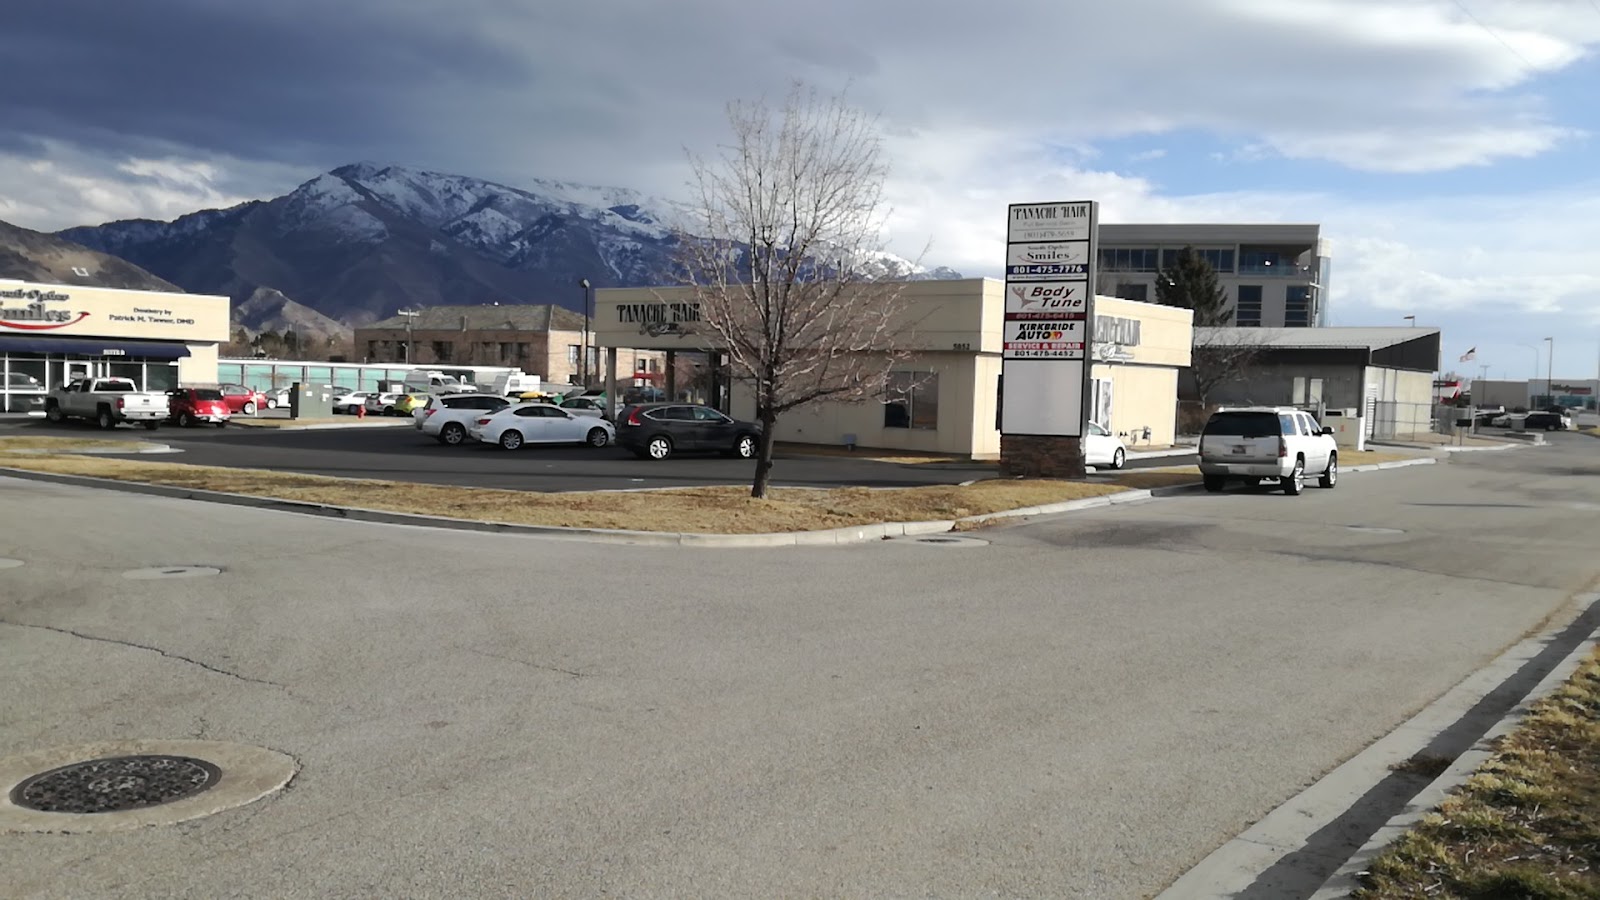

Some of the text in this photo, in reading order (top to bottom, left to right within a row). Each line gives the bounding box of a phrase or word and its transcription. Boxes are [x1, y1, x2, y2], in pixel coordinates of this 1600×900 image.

[1061, 205, 1087, 218] HAIR
[1027, 251, 1070, 260] Smiles
[1013, 265, 1083, 274] 801-475-7776
[1031, 286, 1075, 298] Body
[1041, 297, 1082, 307] Tune
[109, 314, 135, 322] Patrick
[1019, 323, 1075, 331] KIRKBRIDE
[1015, 331, 1051, 340] AUTO
